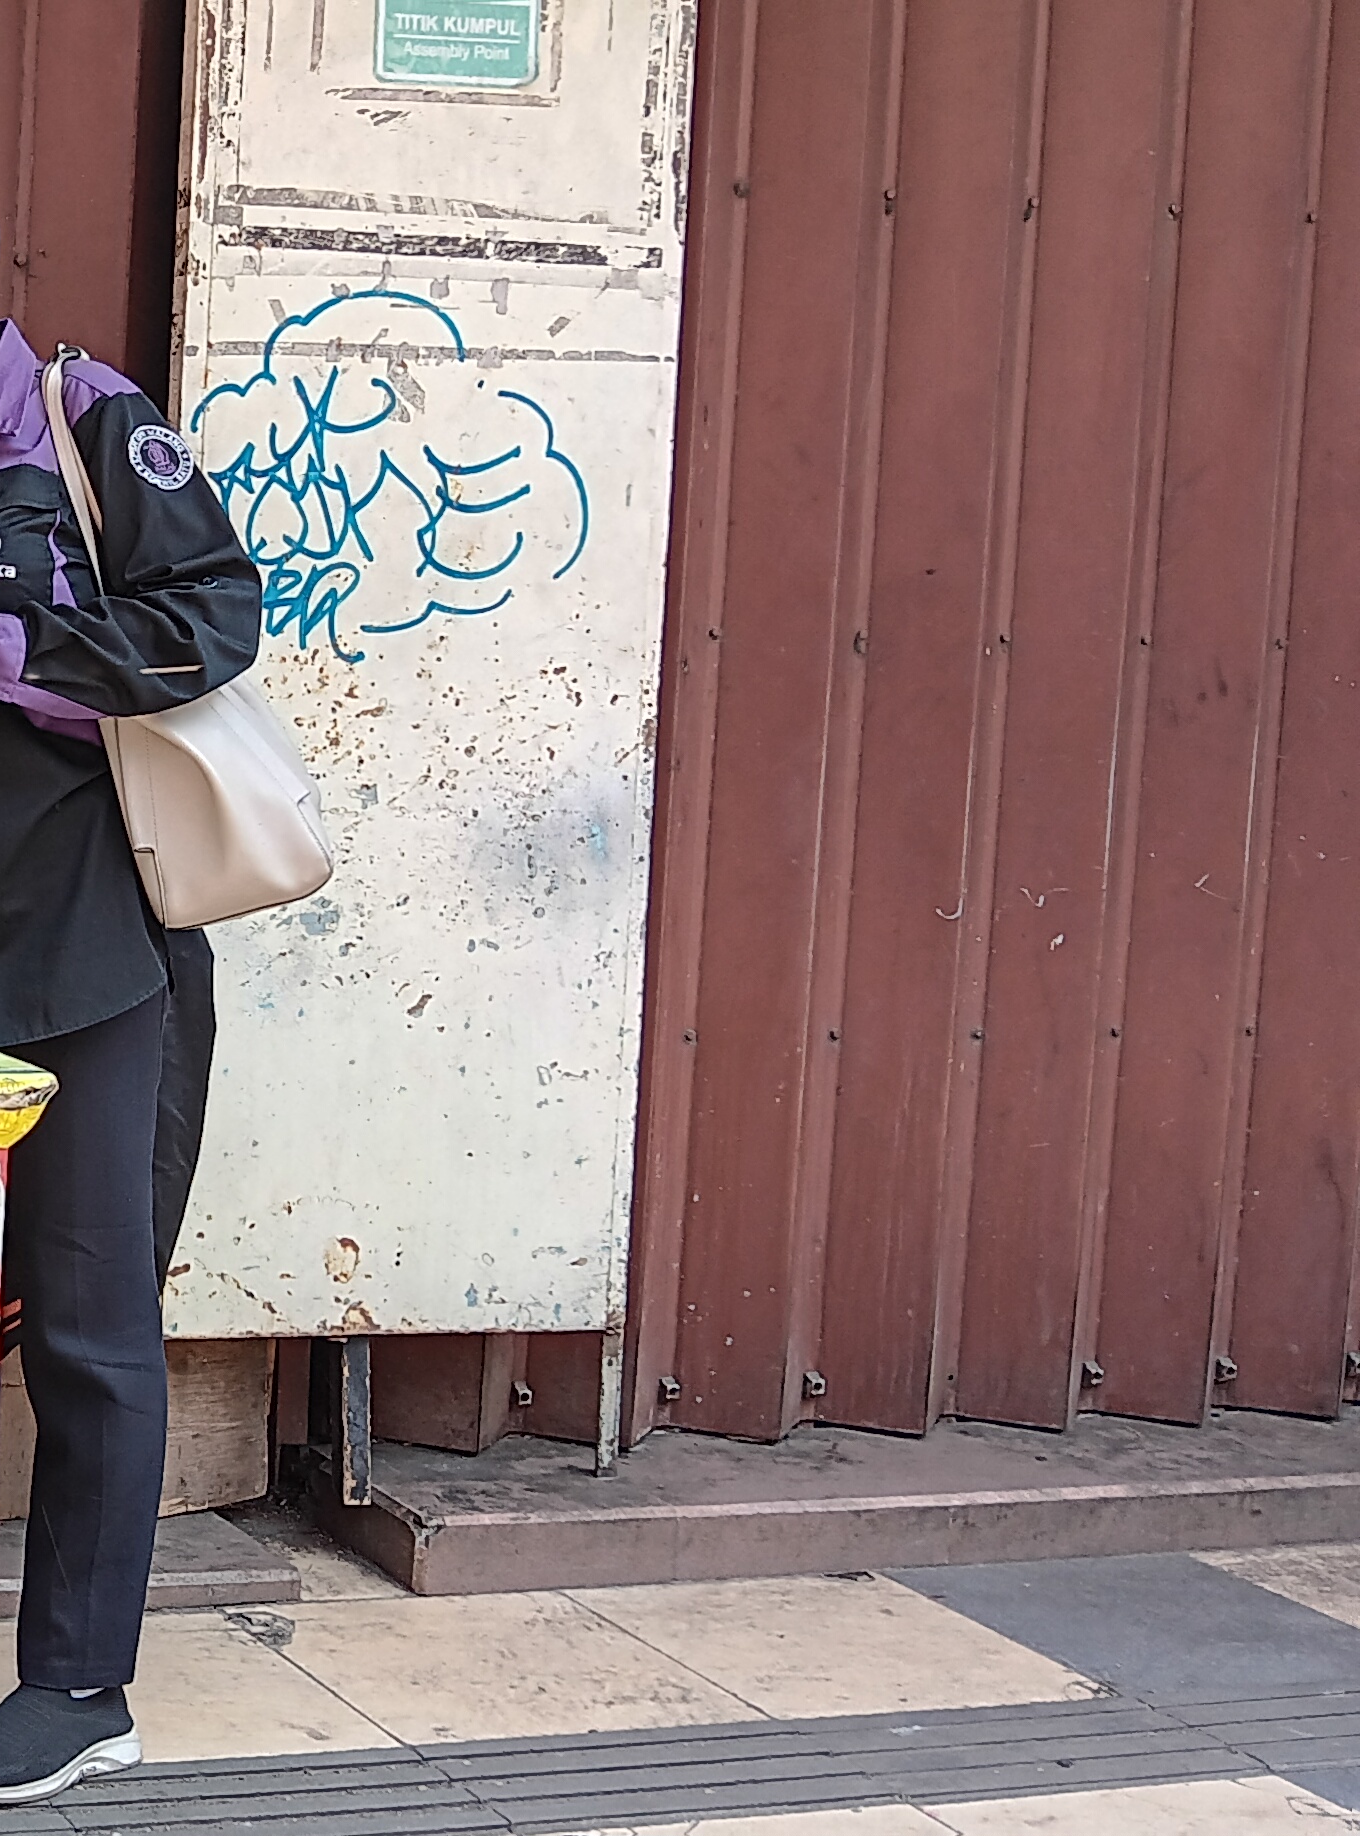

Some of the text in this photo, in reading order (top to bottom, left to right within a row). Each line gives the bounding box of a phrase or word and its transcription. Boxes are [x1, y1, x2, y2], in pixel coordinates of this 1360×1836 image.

[394, 13, 521, 36] TITIK KUMPUL
[404, 42, 510, 61] Assembly Point
